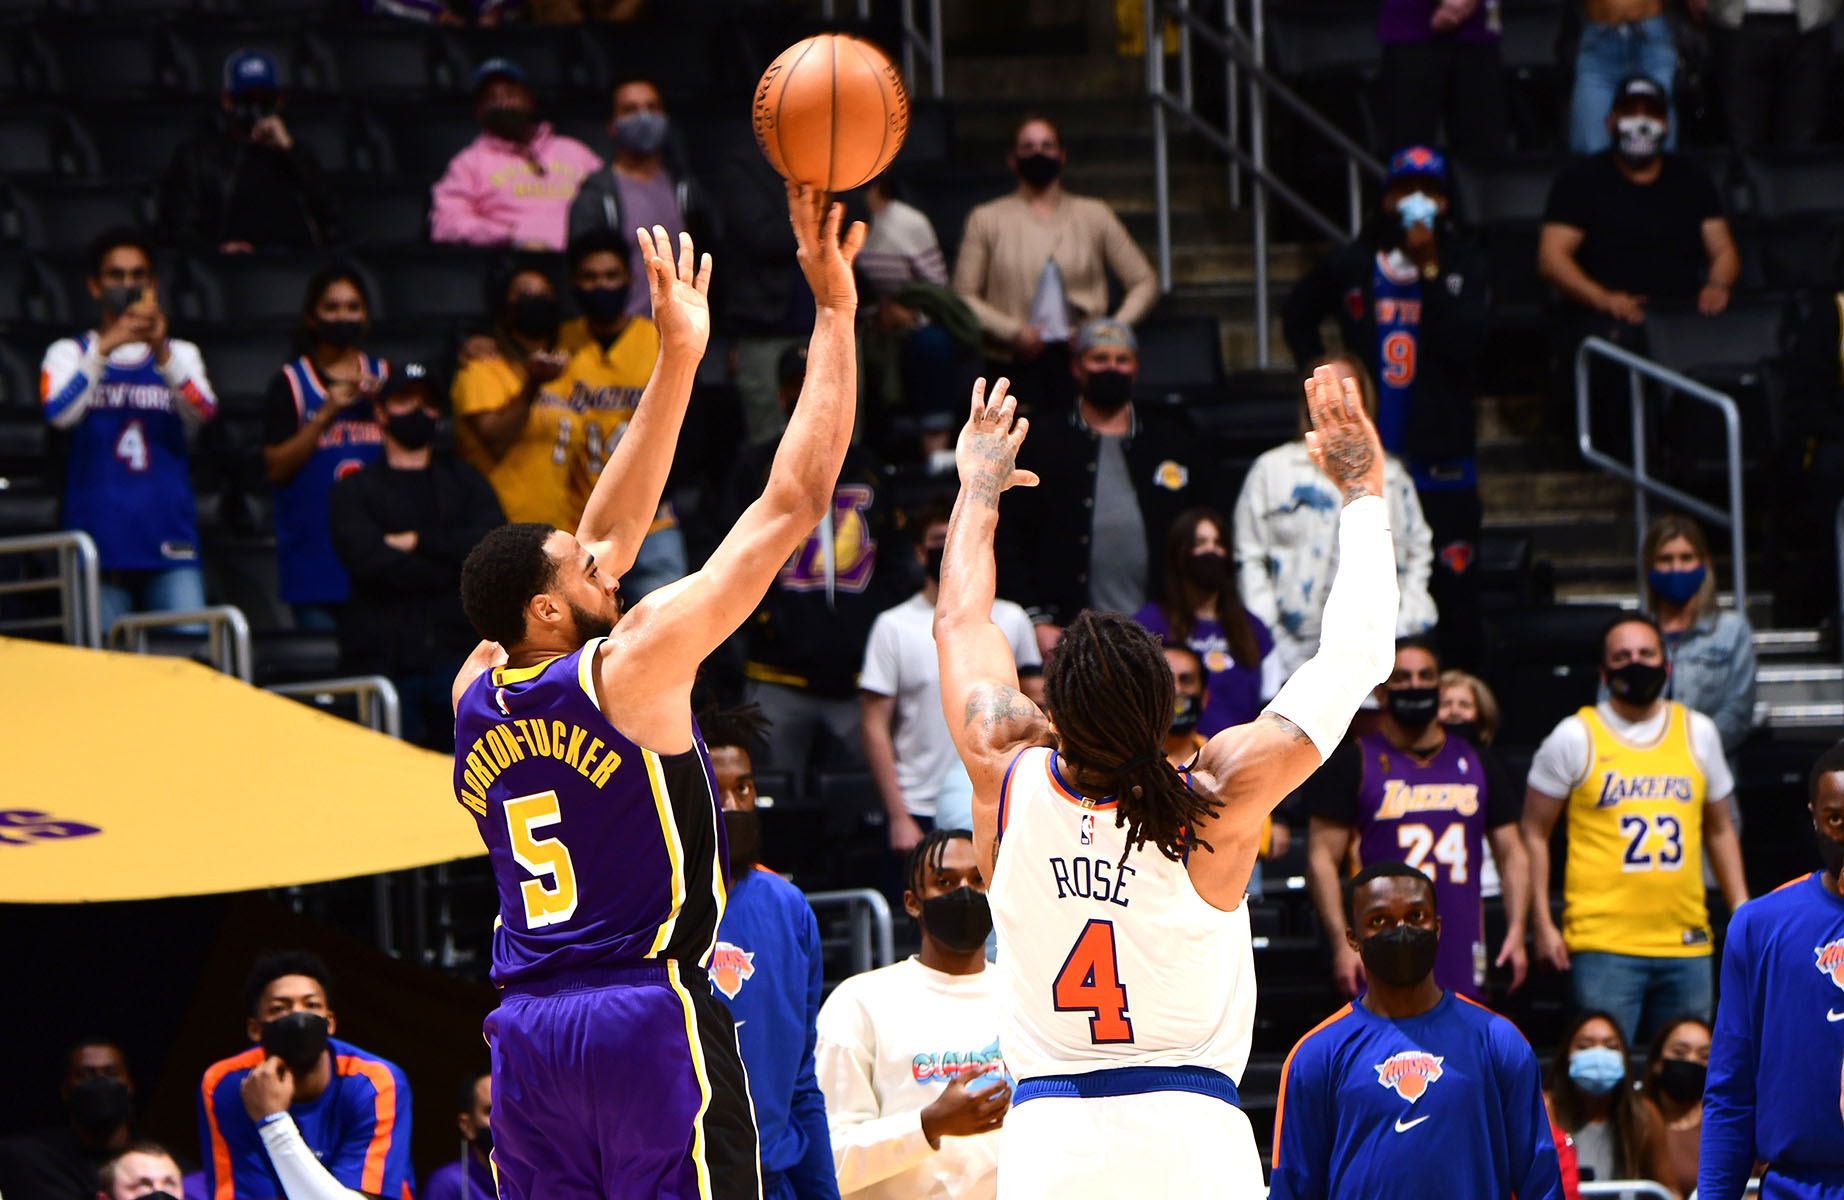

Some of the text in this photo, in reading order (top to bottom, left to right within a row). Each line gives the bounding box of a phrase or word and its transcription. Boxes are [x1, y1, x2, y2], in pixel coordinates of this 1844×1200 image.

[1383, 331, 1416, 389] 9
[114, 417, 151, 473] 4
[460, 717, 622, 818] HORTON-TUCKER
[1594, 769, 1693, 811] LAKERS
[1373, 778, 1480, 822] LAKERS
[502, 789, 578, 930] 5
[1396, 822, 1470, 885] 24
[1617, 812, 1684, 873] 23
[1049, 856, 1136, 908] ROSE
[1052, 917, 1135, 1045] 4
[1380, 1055, 1441, 1083] KNICKS
